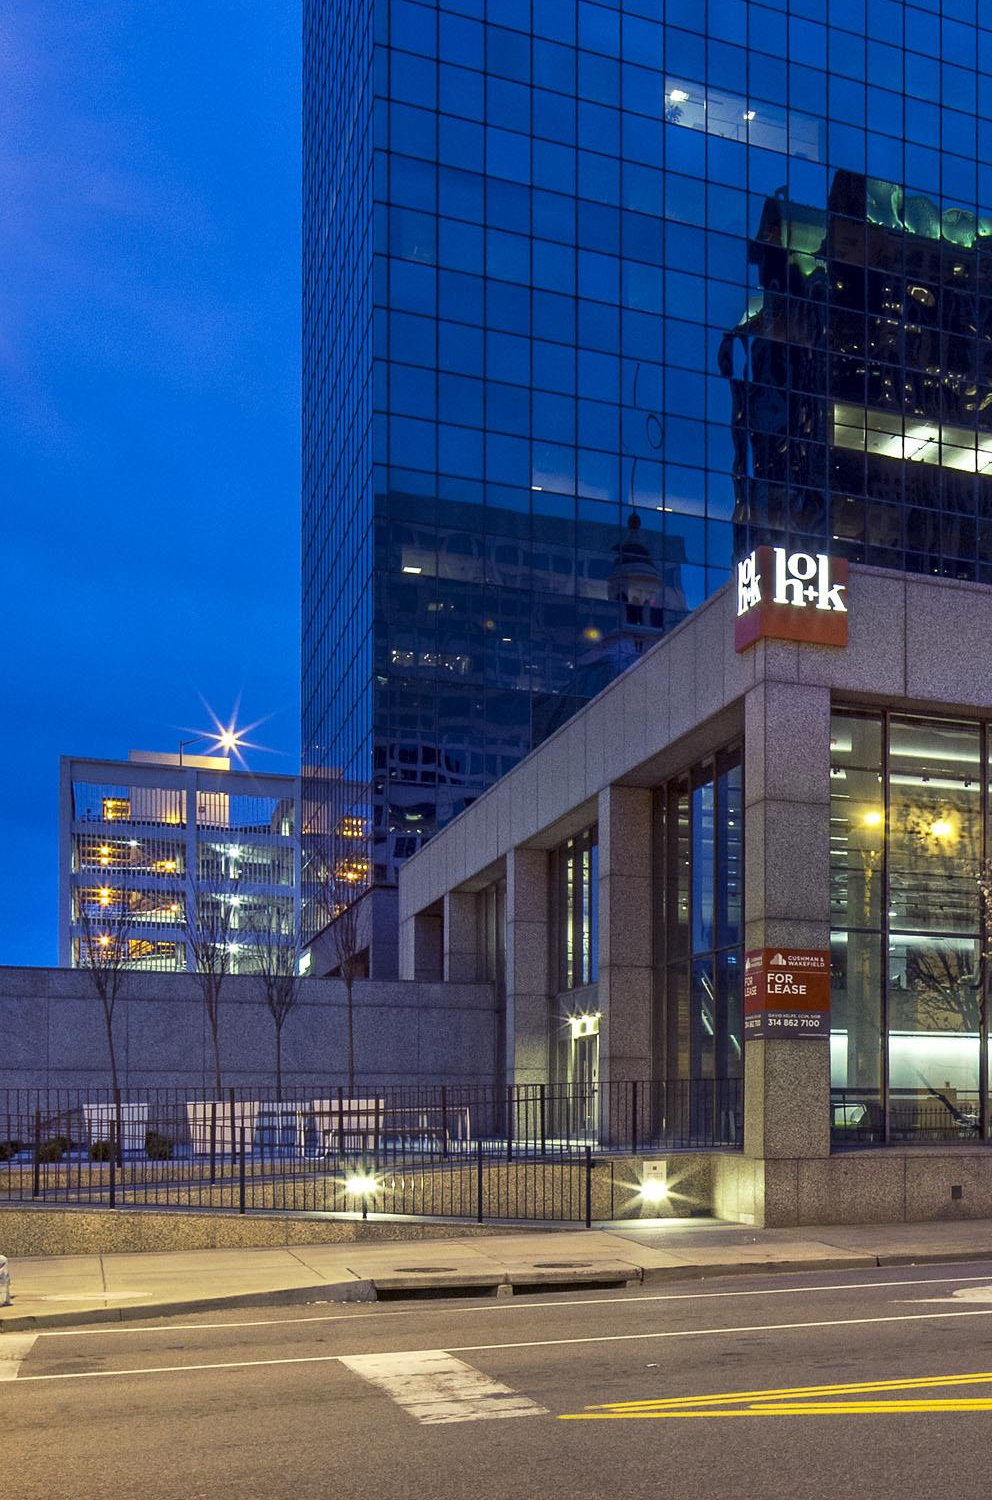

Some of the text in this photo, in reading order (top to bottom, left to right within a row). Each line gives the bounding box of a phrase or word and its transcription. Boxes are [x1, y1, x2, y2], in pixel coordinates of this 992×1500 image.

[767, 973, 794, 984] FOR
[767, 983, 807, 995] LEASE
[767, 1018, 782, 1026] 314
[783, 1019, 799, 1027] 862
[800, 1019, 820, 1028] 7100
